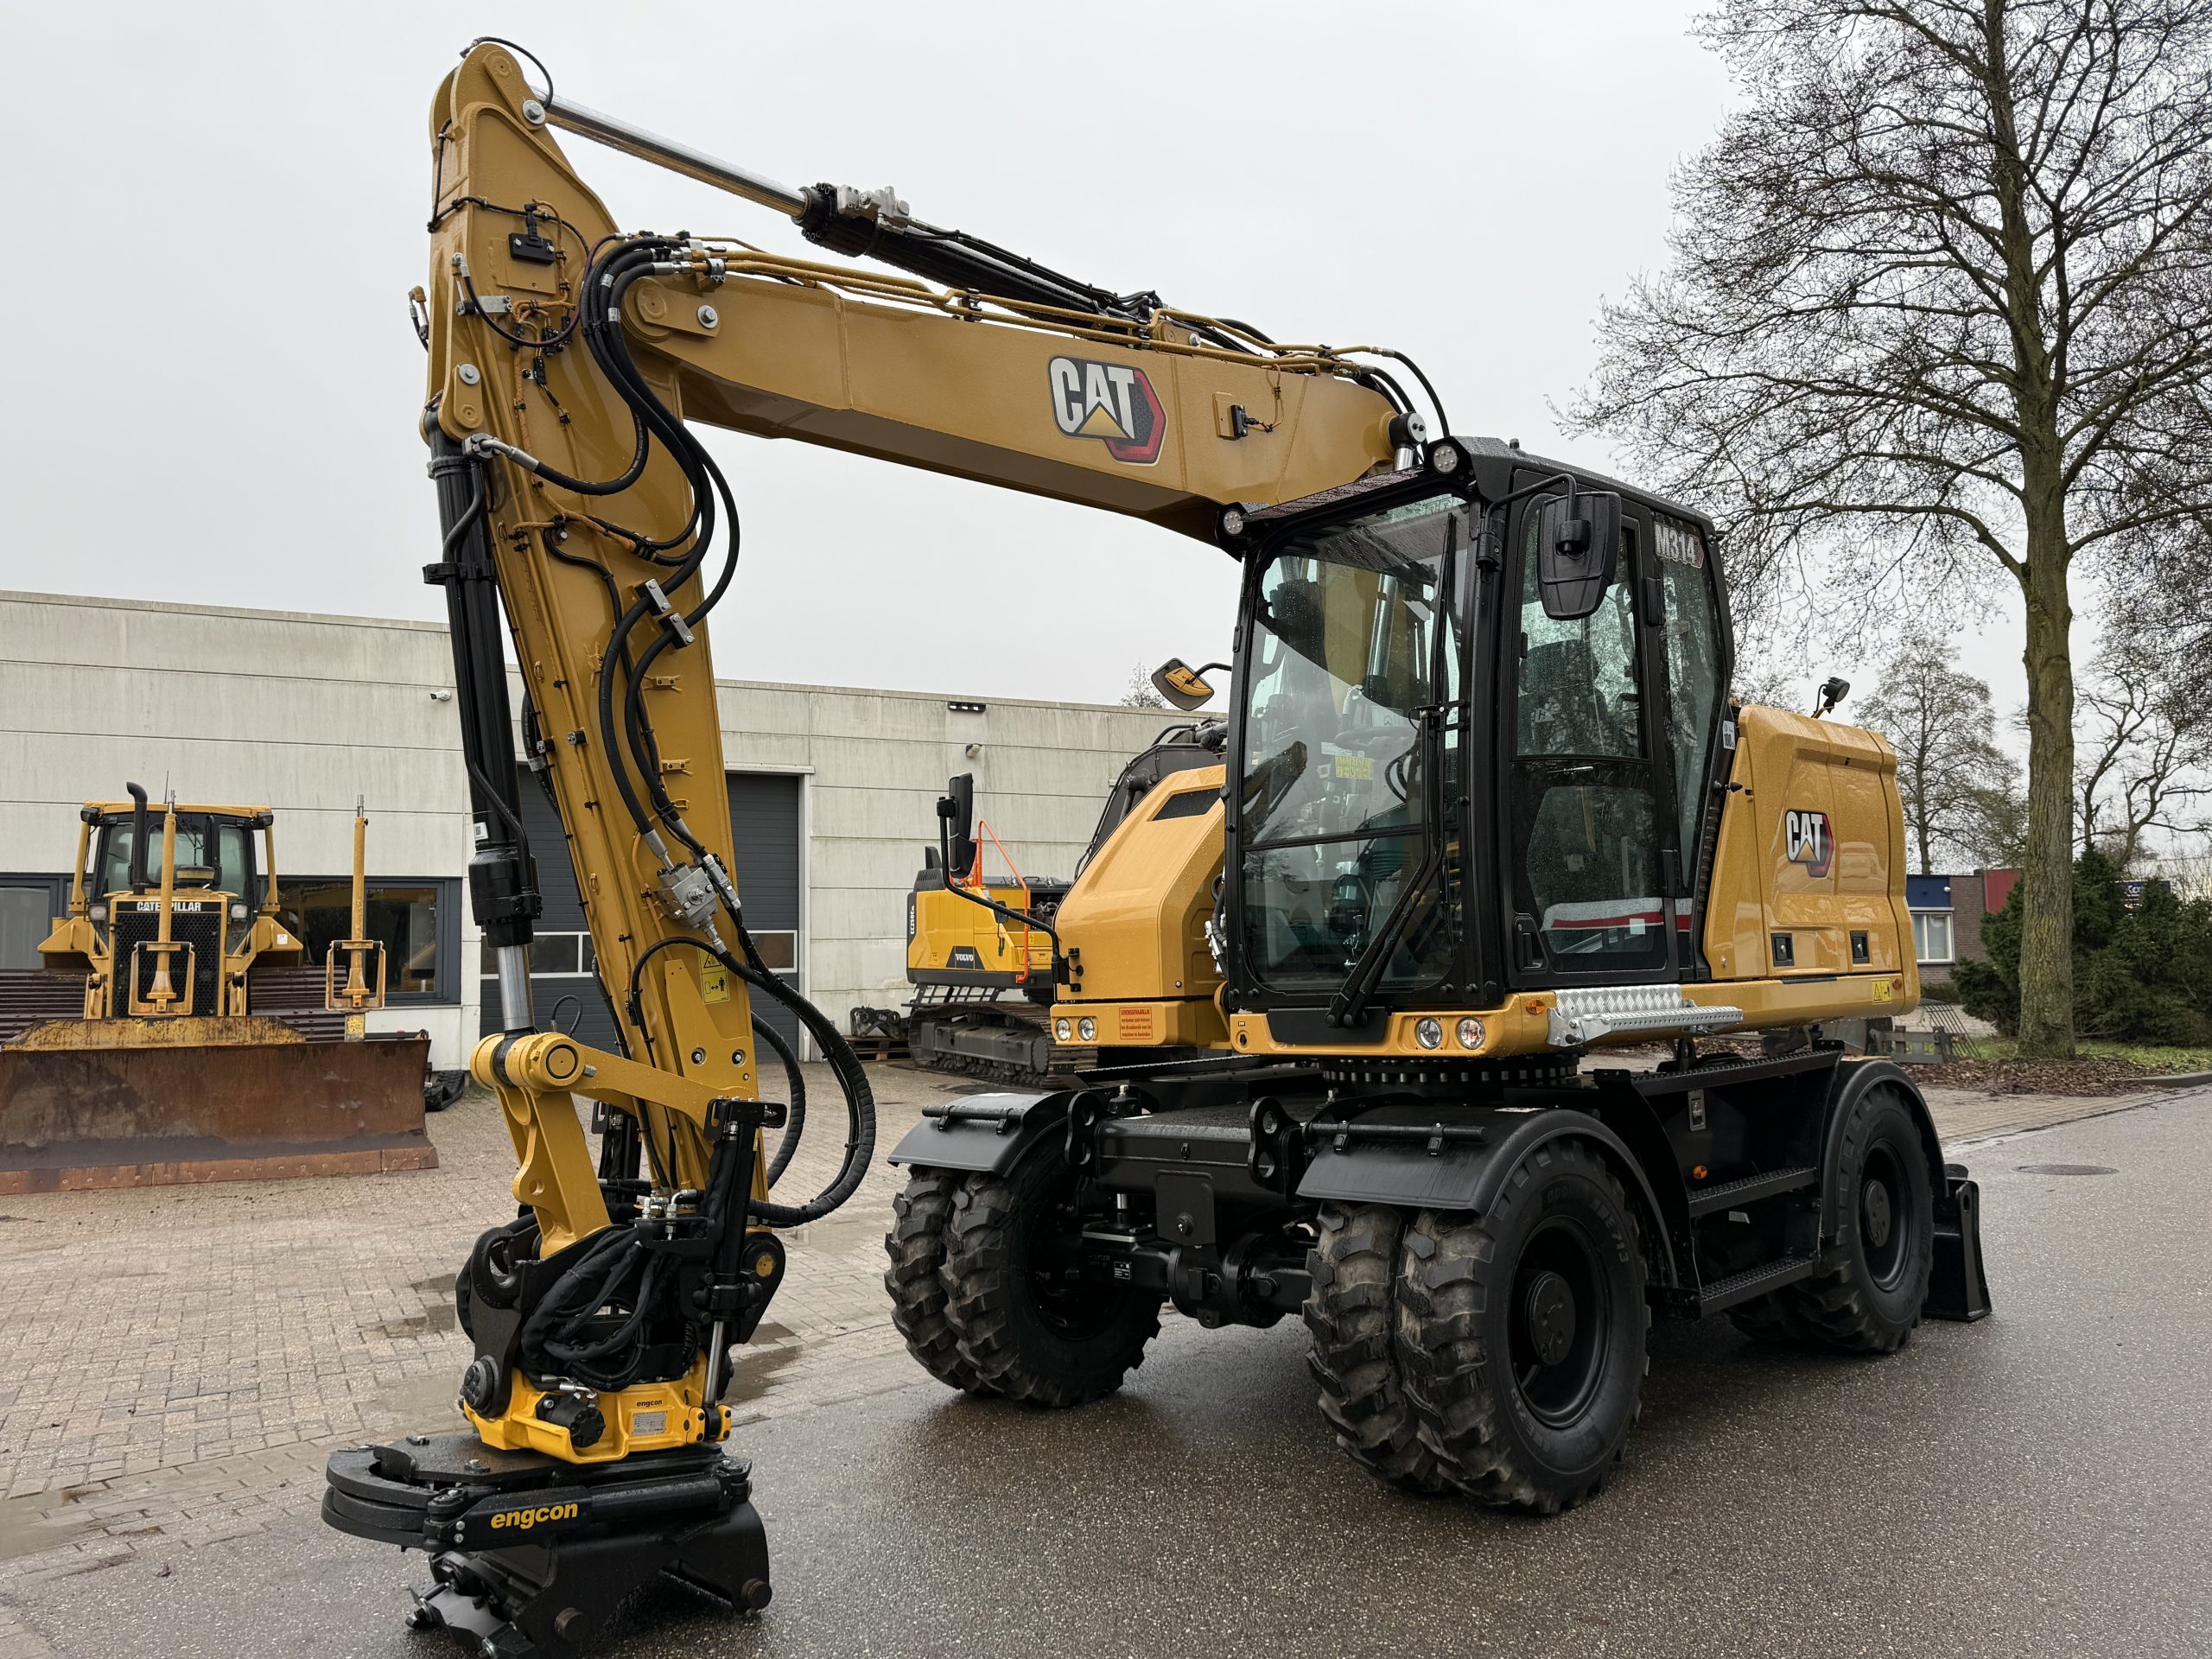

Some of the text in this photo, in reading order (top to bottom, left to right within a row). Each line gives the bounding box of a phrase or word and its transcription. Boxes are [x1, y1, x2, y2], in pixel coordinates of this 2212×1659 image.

[1051, 358, 1135, 439] CAT
[1655, 524, 1696, 564] M314
[1786, 810, 1823, 862] CAT
[137, 901, 202, 912] CATEILLAR
[955, 953, 974, 962] VOLVO
[1611, 1230, 1630, 1263] 713
[491, 1503, 579, 1529] engcon
